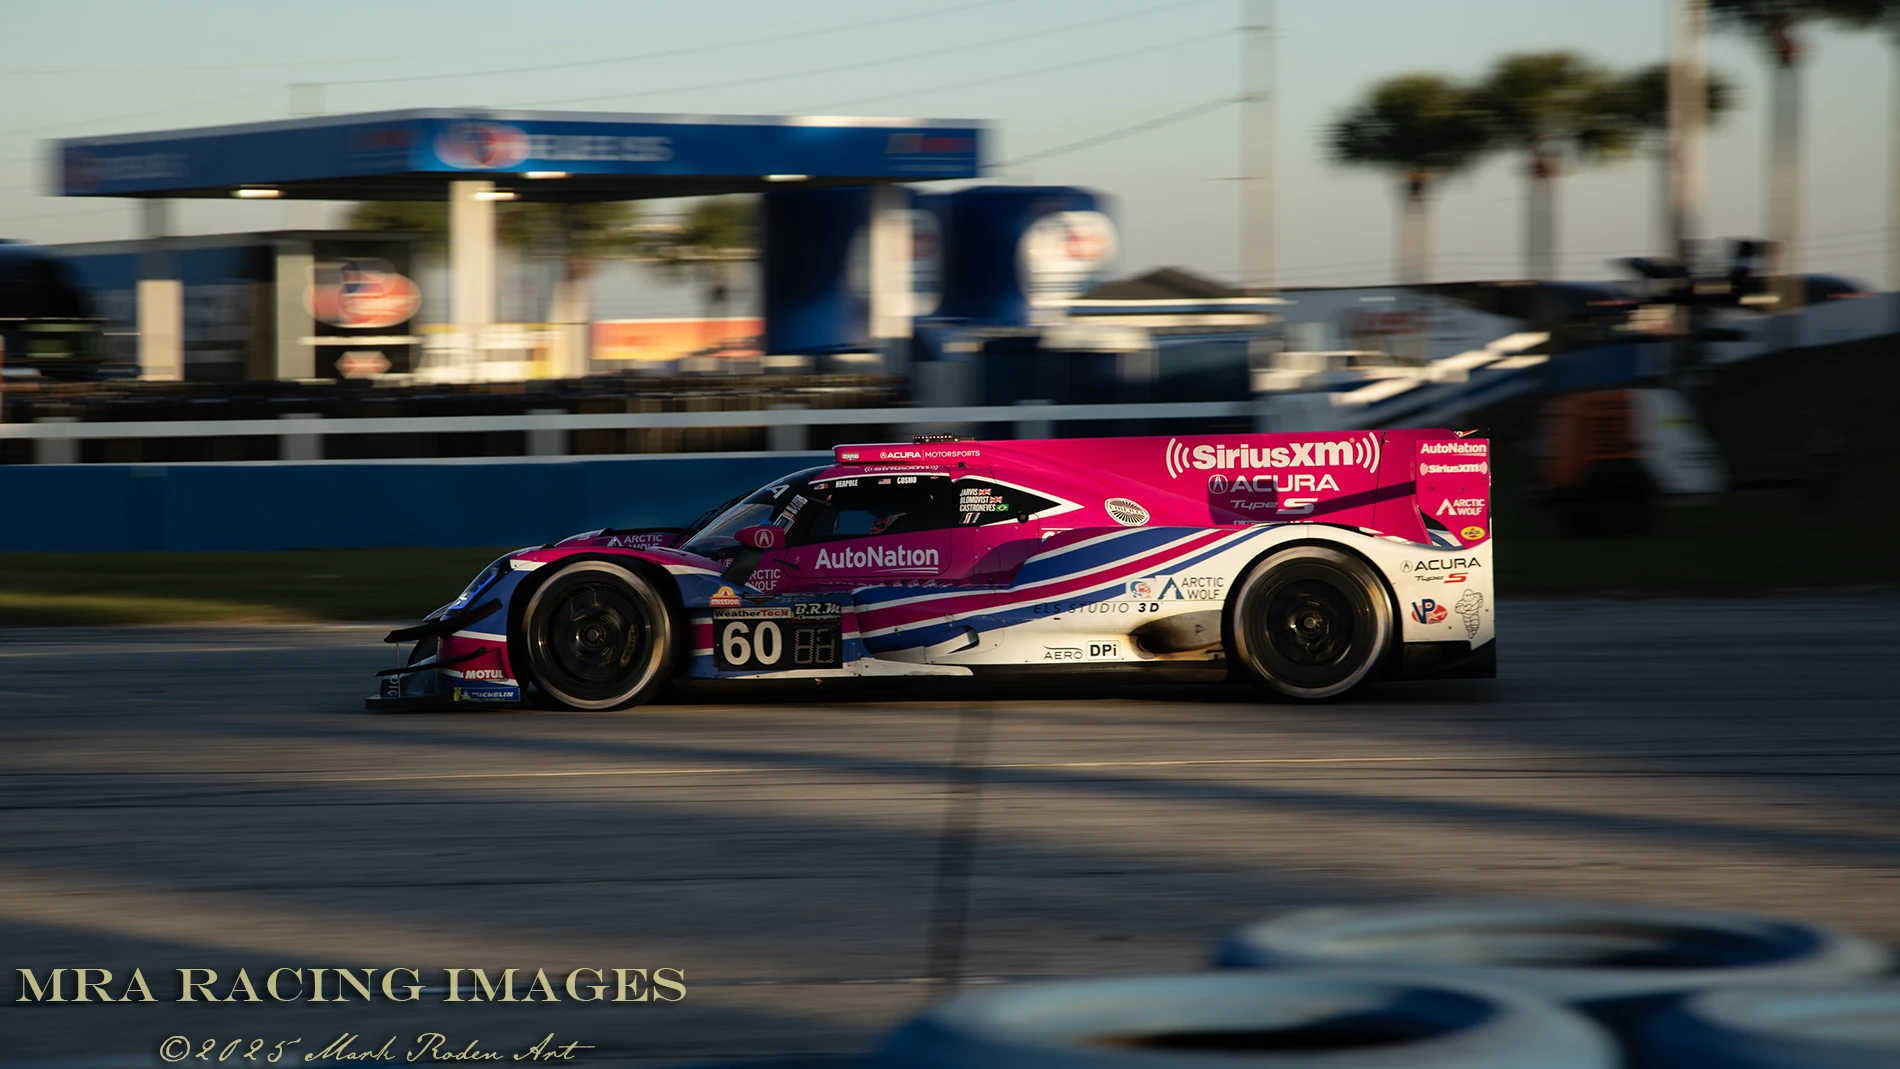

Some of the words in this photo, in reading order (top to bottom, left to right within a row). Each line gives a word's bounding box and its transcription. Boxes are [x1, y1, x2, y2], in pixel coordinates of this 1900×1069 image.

[1420, 443, 1487, 454] AutoNation
[886, 451, 922, 459] ACURA
[925, 450, 981, 458] MOTORSPORTS
[897, 476, 917, 484] COSMO
[1230, 473, 1340, 493] ACURA
[959, 488, 978, 497] JARVIS
[1276, 497, 1319, 514] S
[1453, 498, 1486, 507] ARCTIC
[959, 504, 996, 512] CASTRONEVES
[1457, 507, 1483, 516] WOLF
[623, 534, 663, 543] ARCTIC
[814, 545, 939, 570] AutoNation
[1414, 557, 1482, 571] ACURA
[749, 569, 781, 579] RCTIC
[1443, 572, 1469, 584] S
[1181, 577, 1225, 588] ARCTIC
[1186, 589, 1221, 600] WOLF
[1033, 602, 1062, 614] ELS
[1068, 602, 1130, 614] STUDIO
[714, 609, 789, 618] WeatherTech
[722, 620, 783, 666] 60
[1043, 651, 1083, 660] AERO
[1090, 644, 1117, 657] DPi
[465, 669, 504, 679] MOTUL
